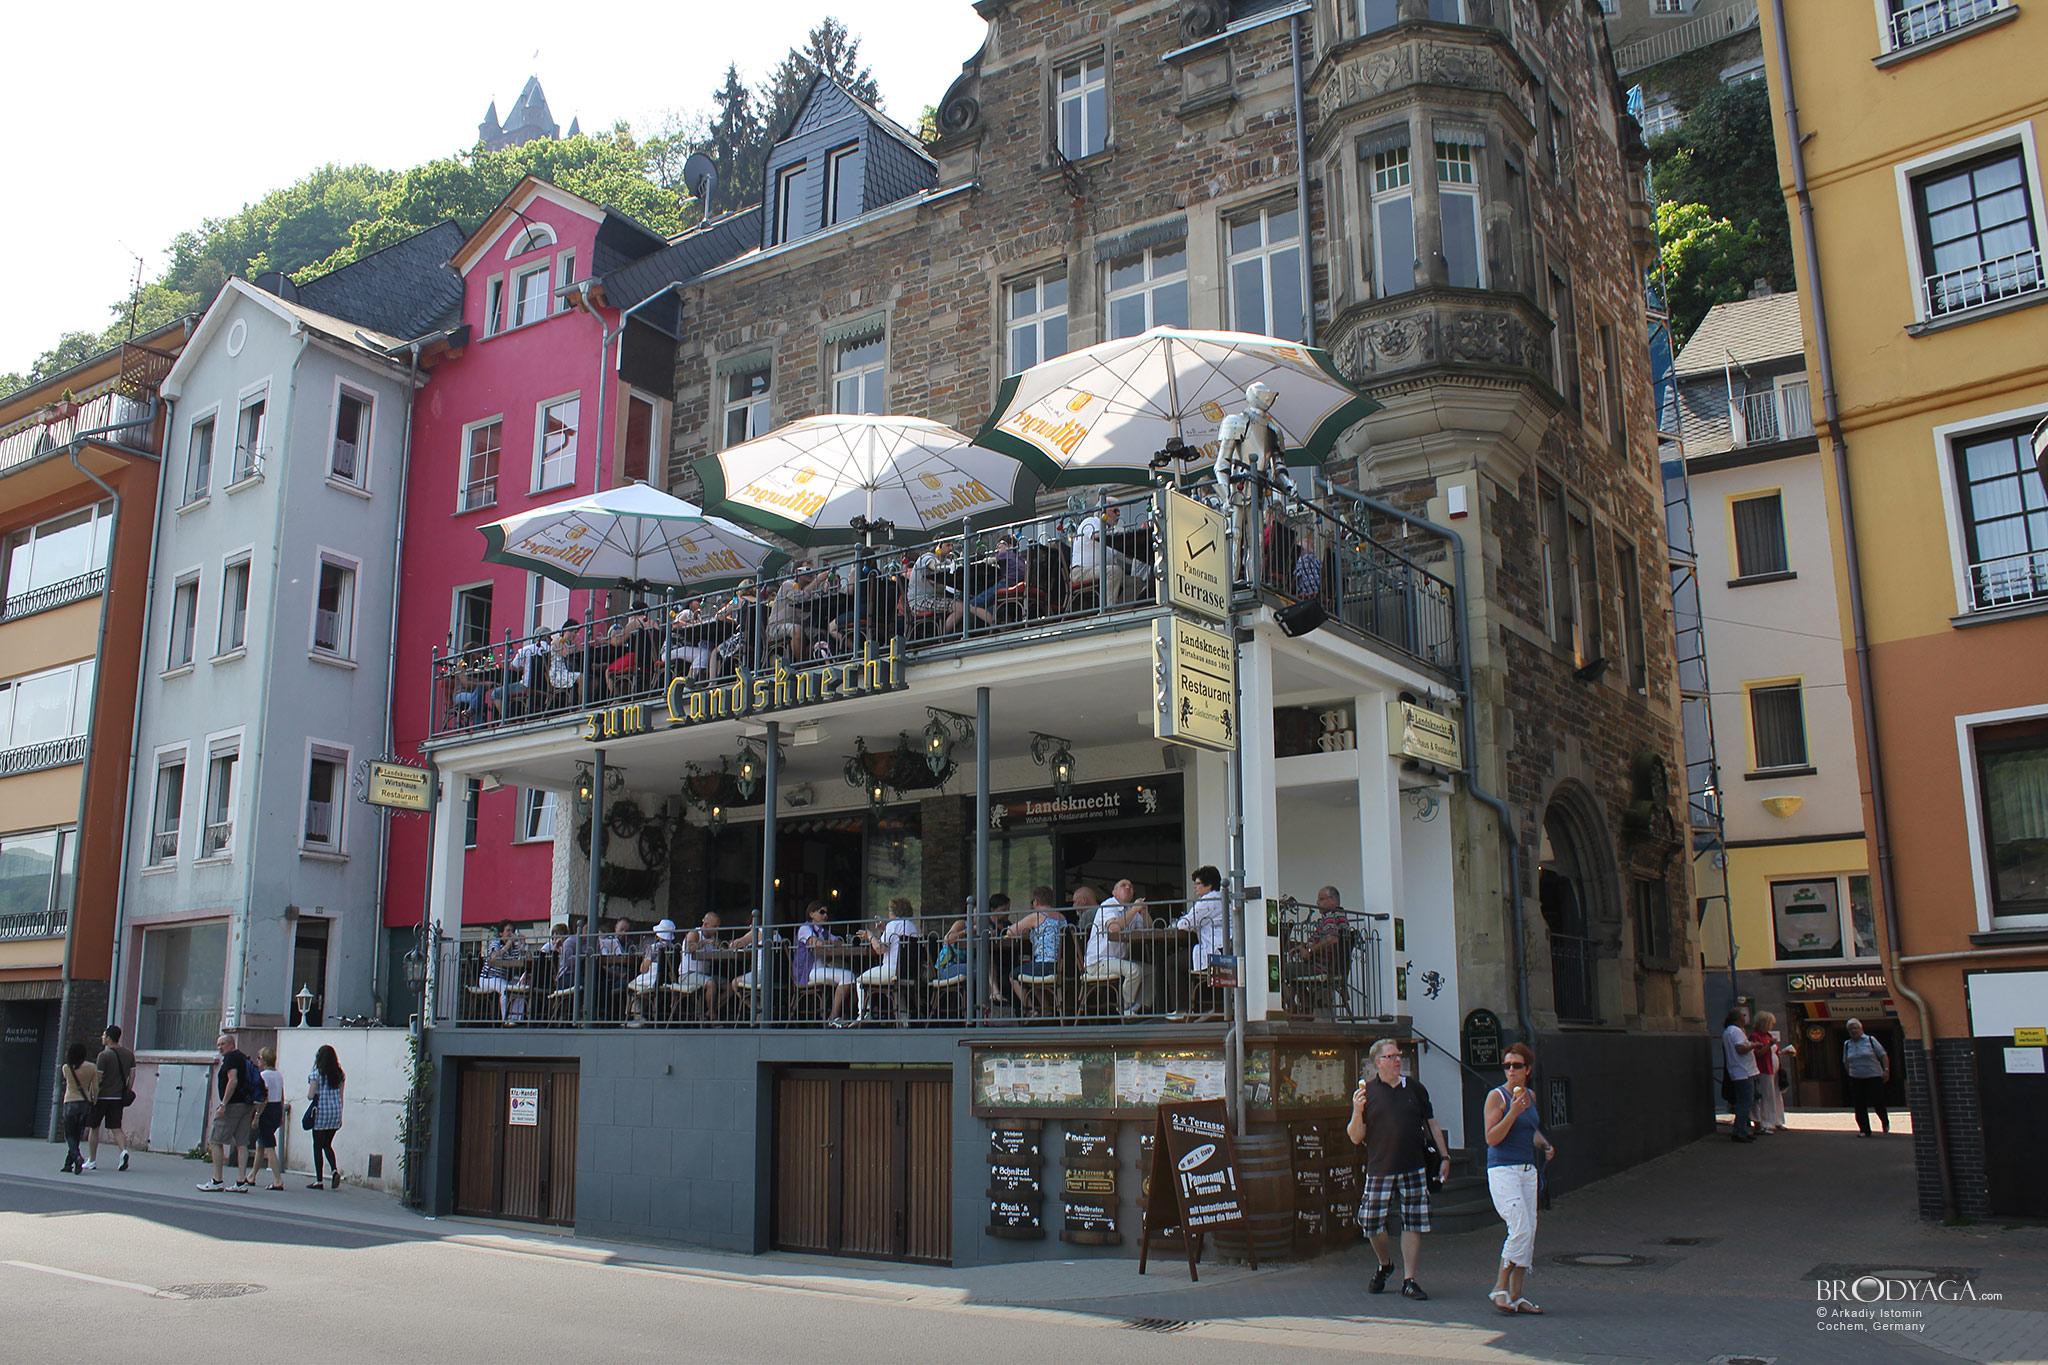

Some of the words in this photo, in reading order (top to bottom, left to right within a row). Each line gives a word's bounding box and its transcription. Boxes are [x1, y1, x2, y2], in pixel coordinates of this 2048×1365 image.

[1183, 561, 1218, 584] Panorama
[1176, 574, 1225, 609] Terrasse
[1180, 631, 1230, 660] Landsknecht
[1180, 648, 1204, 662] Wirtshaus
[583, 704, 650, 741] zum
[666, 635, 908, 728] Landsknecht
[1181, 674, 1231, 704] Restaurant
[384, 779, 417, 789] Wirtshaus
[381, 789, 419, 801] Restaurant
[1025, 792, 1120, 815] Landsknecht
[1026, 814, 1052, 824] Wirtshaus
[1058, 811, 1089, 821] Restaurant
[6, 1027, 38, 1035] Ausfahrt
[1172, 1113, 1179, 1124] 2
[1180, 1117, 1187, 1125] x
[1189, 1116, 1225, 1132] Terrasse
[999, 1166, 1030, 1177] Schnitzel
[1187, 1170, 1226, 1189] Panorama
[1195, 1184, 1222, 1196] Terrasse
